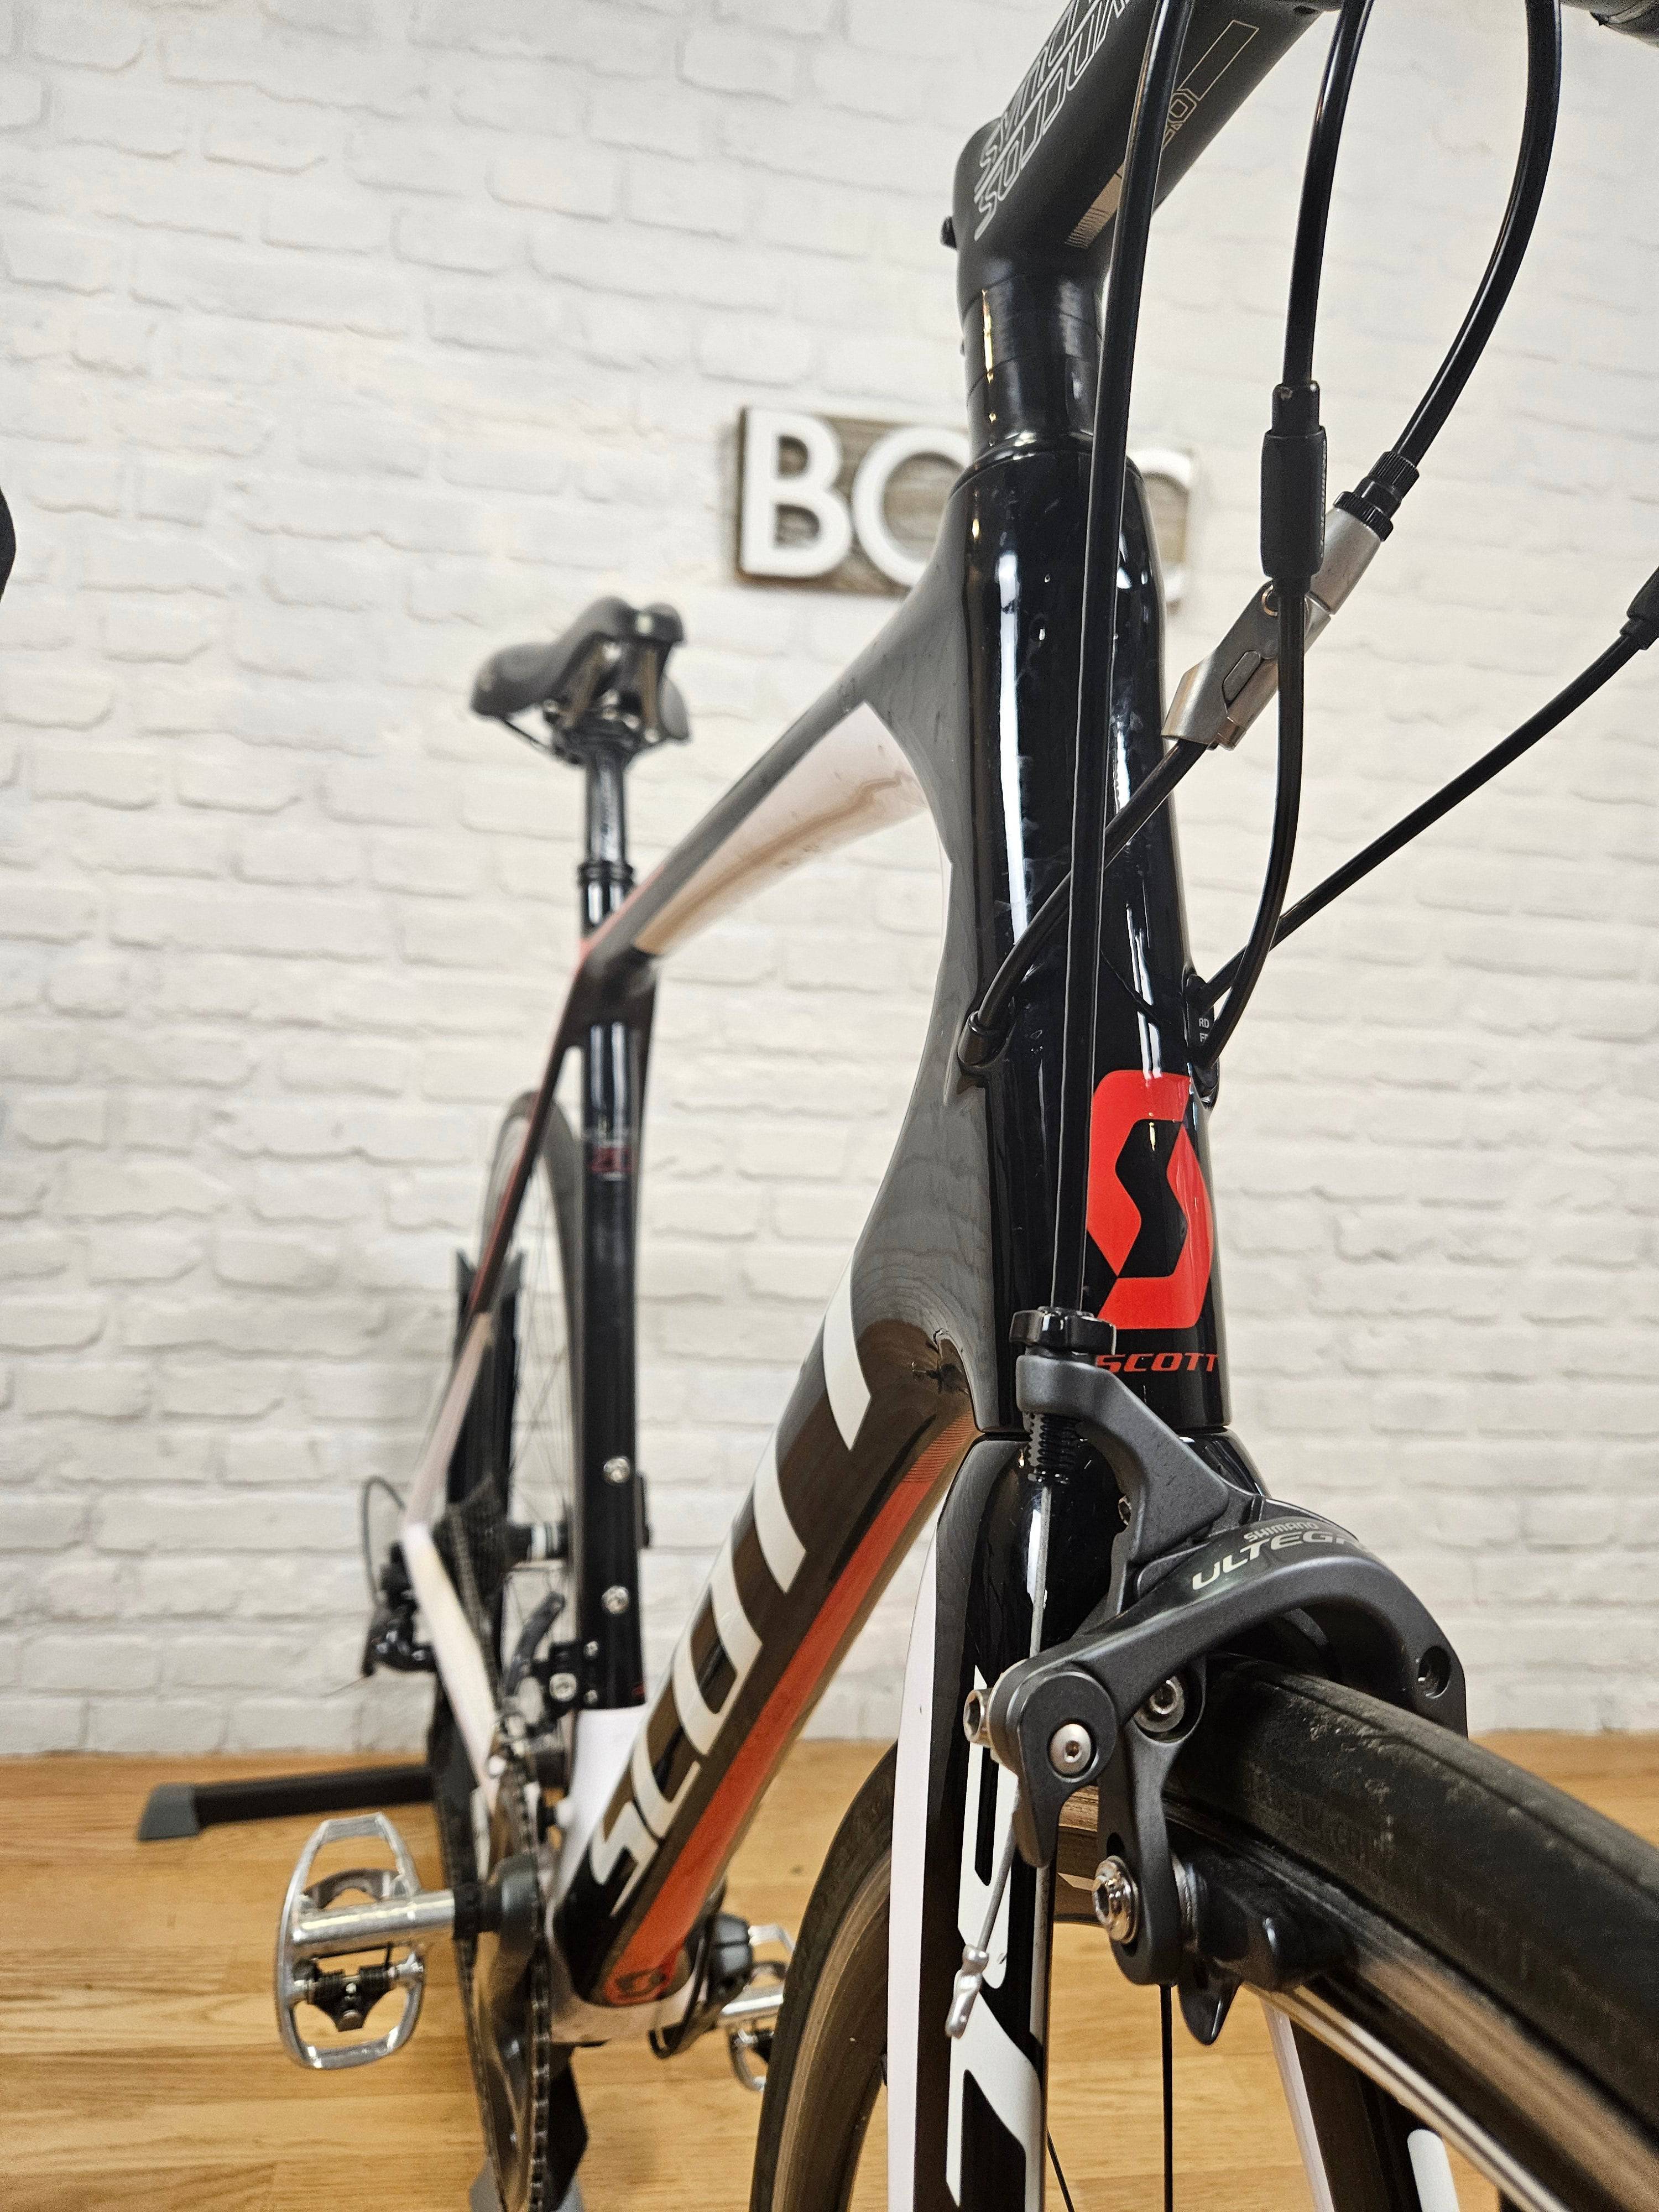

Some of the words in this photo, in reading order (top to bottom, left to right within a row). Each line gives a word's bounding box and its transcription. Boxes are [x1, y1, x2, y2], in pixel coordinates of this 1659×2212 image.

[1198, 1018, 1209, 1029] RD
[1096, 1353, 1219, 1373] SCOTT
[1244, 1521, 1319, 1542] SHIMANO
